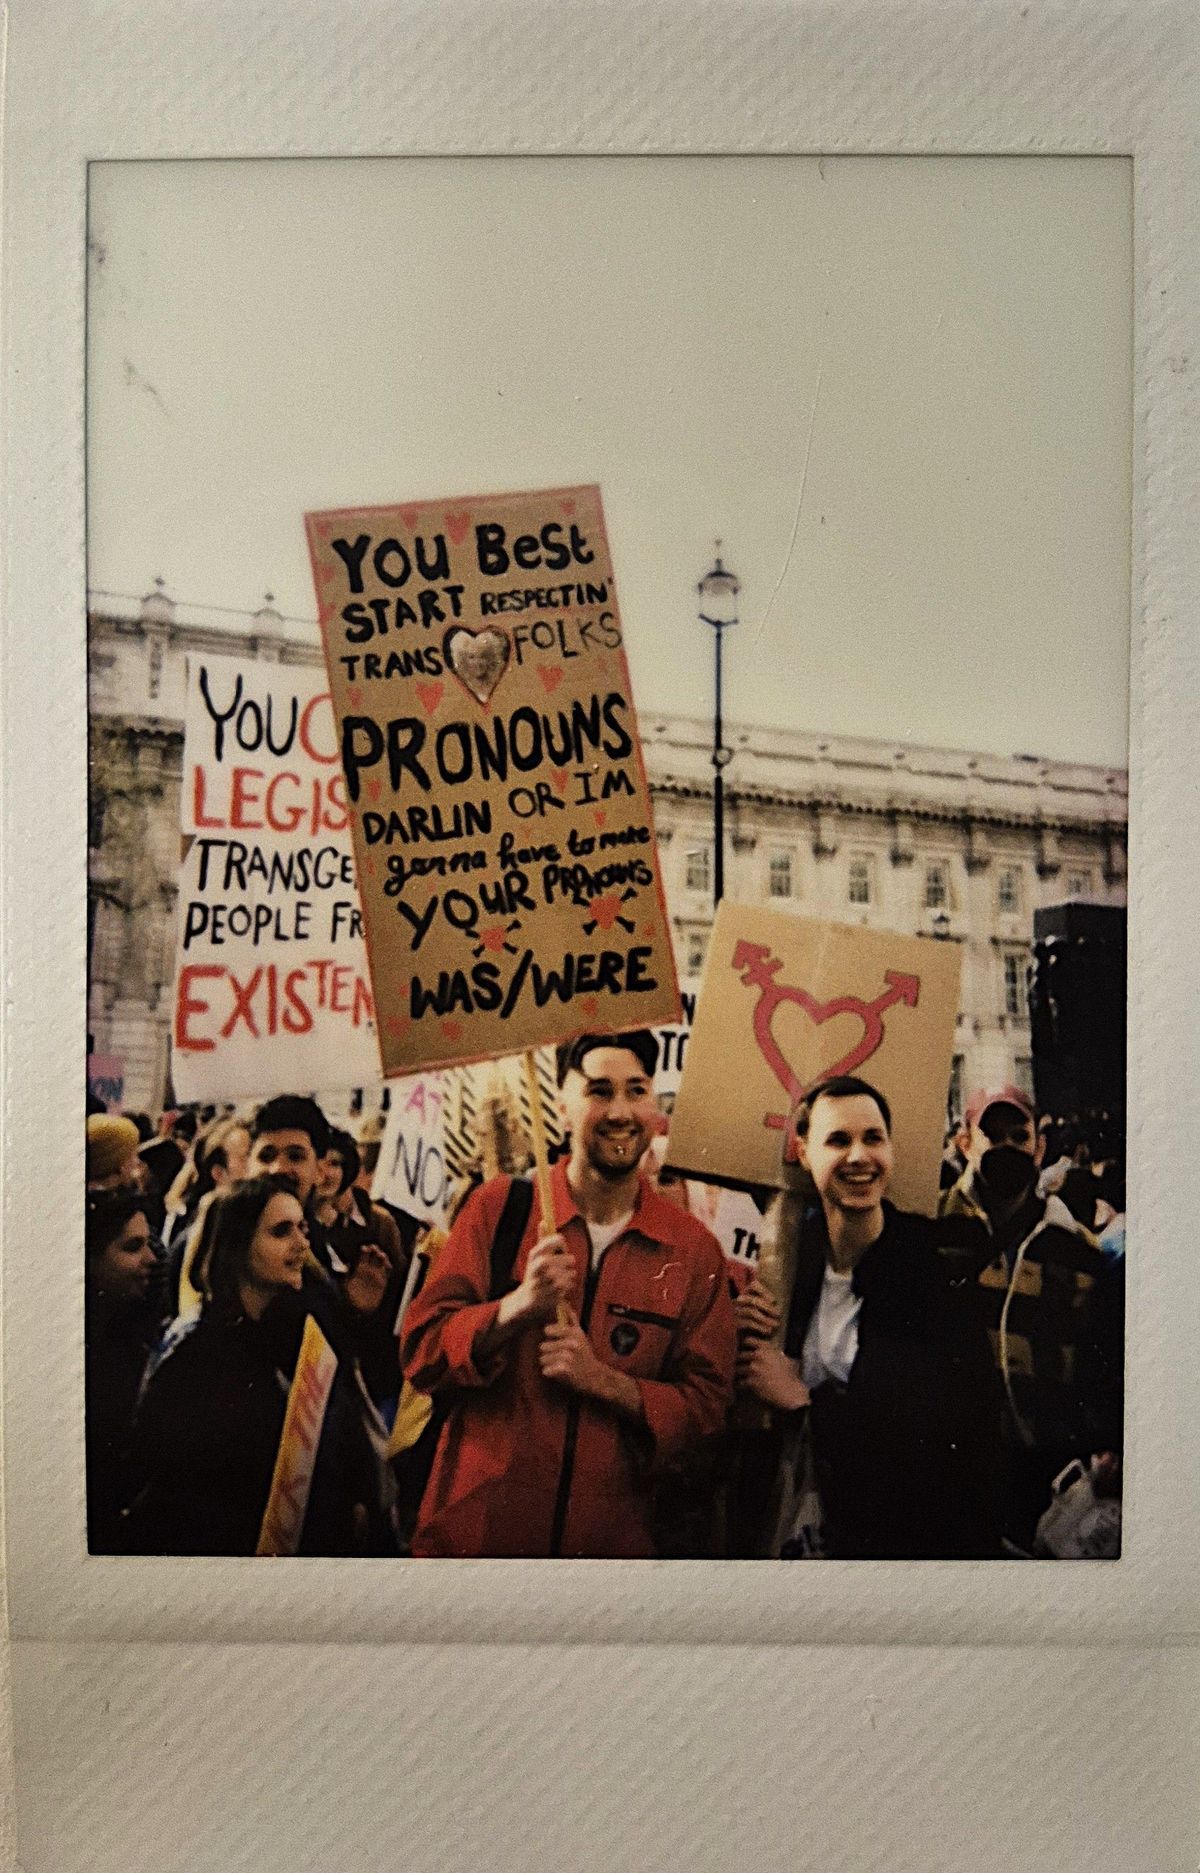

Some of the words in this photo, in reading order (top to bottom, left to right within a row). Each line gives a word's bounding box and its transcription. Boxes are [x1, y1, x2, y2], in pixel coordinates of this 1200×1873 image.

[332, 534, 450, 593] YOU
[341, 585, 464, 643] START
[480, 577, 614, 616] RESPECTIN'
[340, 646, 444, 681] TRANS
[513, 612, 622, 665] FOLKS
[200, 666, 298, 761] YOU
[341, 692, 633, 800] PRONOUNS
[362, 800, 492, 845] DARLIN
[508, 782, 565, 818] OR
[383, 850, 487, 897] gonna
[497, 832, 561, 871] have
[567, 830, 596, 857] to
[599, 826, 651, 849] make
[184, 902, 310, 950] PEOPLE
[397, 870, 537, 950] YOUR
[543, 859, 654, 905] PRONOUNS
[410, 947, 658, 1019] WAS/WERE
